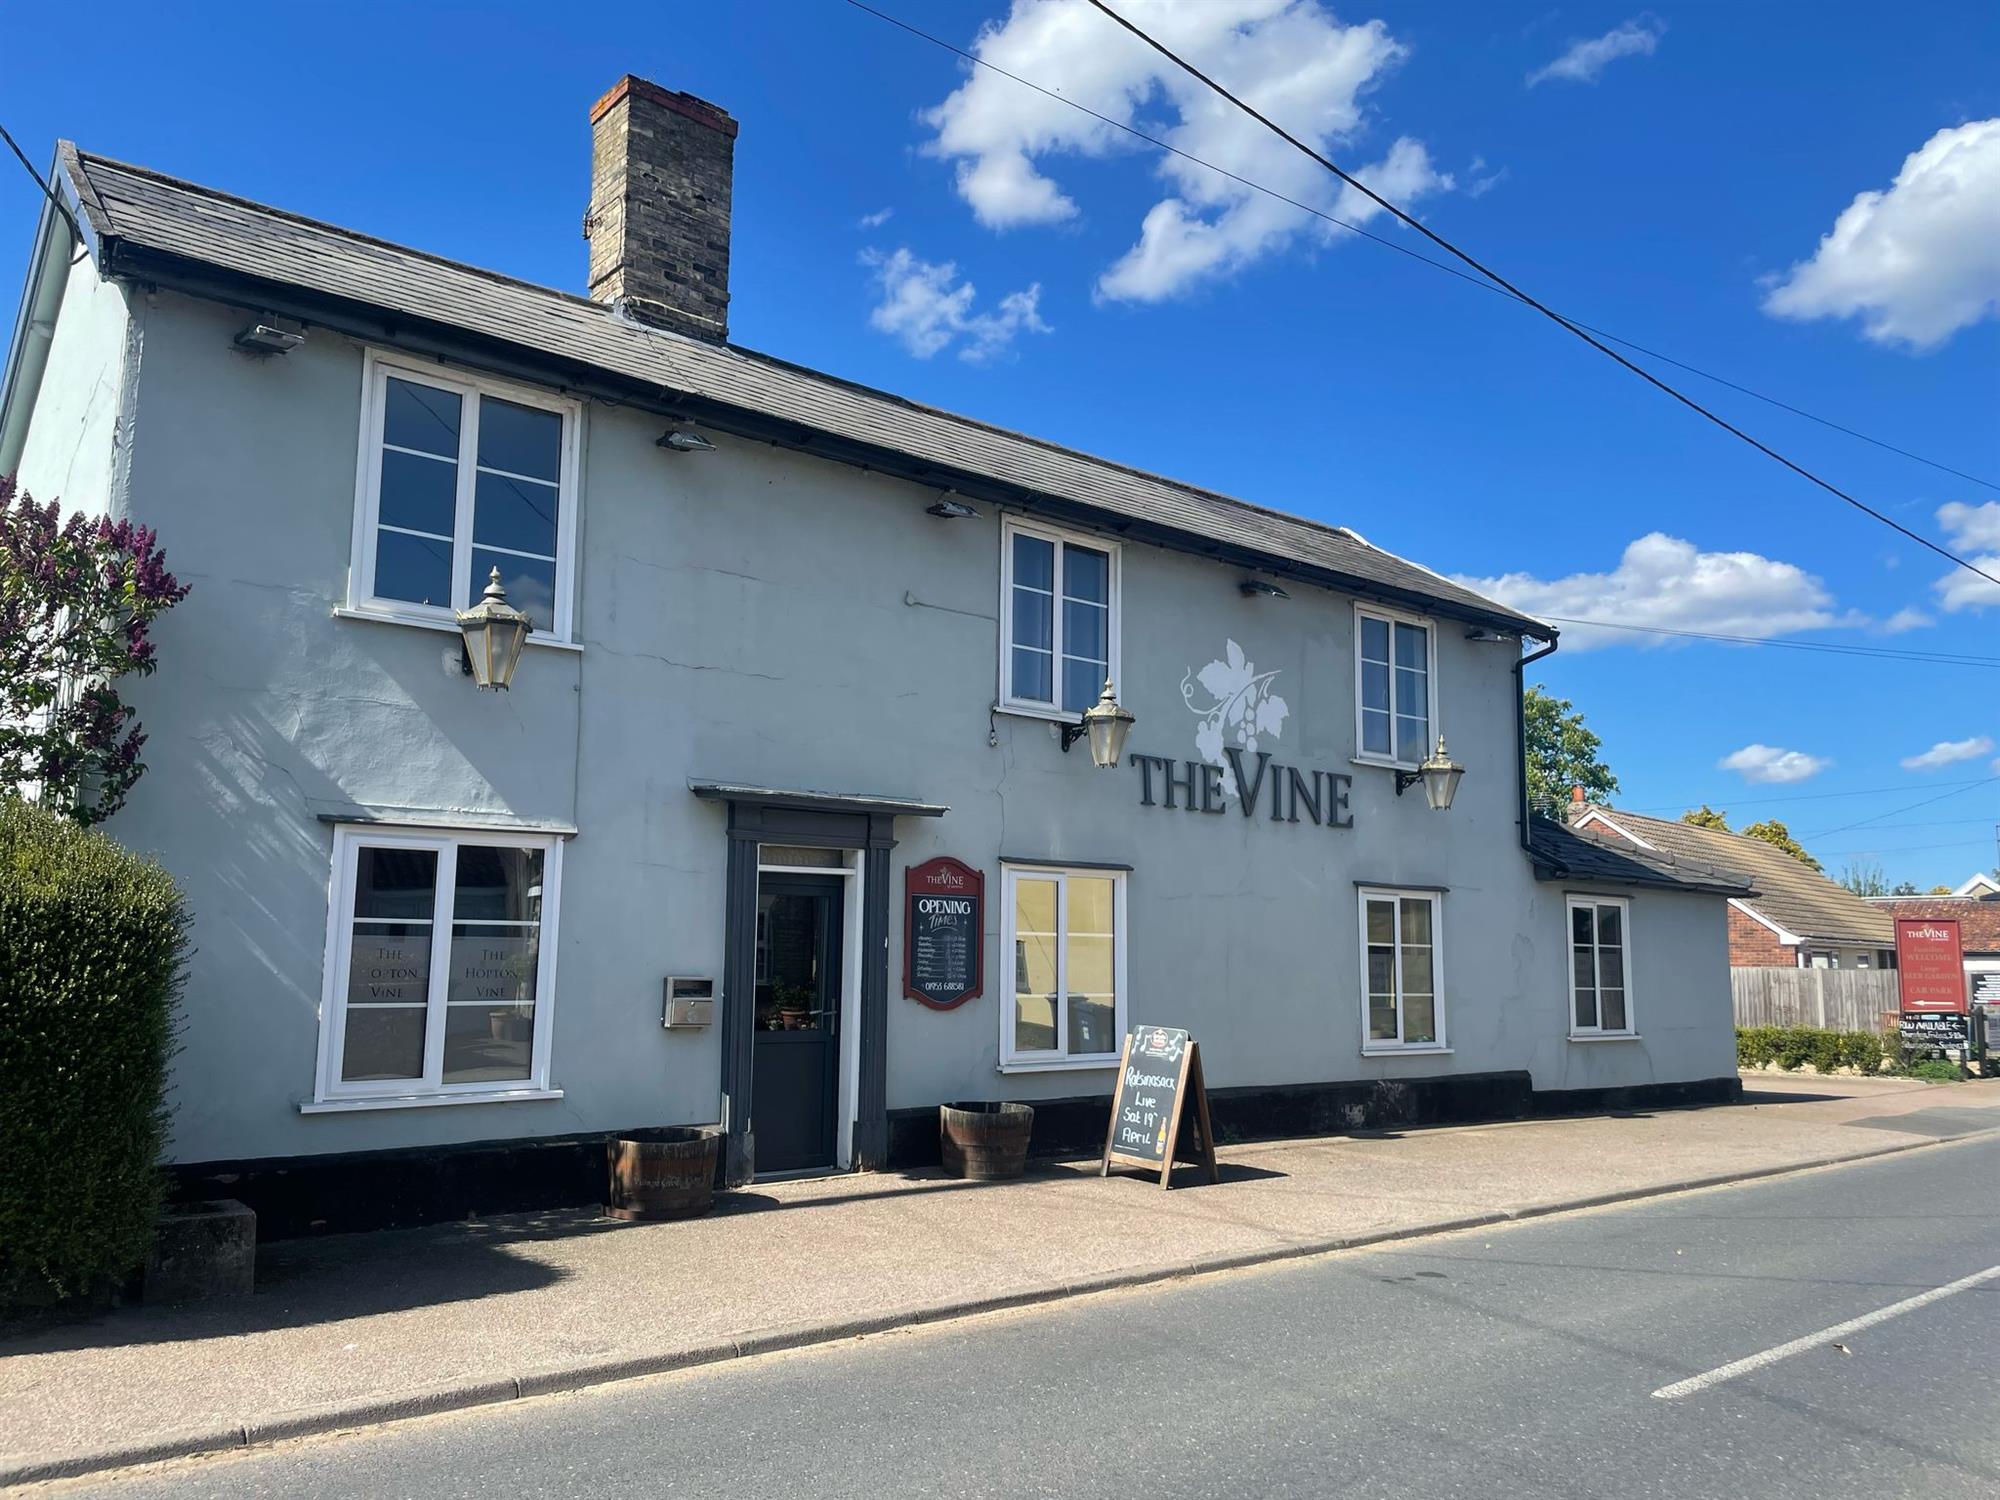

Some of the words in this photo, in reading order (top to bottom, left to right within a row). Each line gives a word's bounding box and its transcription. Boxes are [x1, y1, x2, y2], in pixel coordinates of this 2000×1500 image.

[1130, 753, 1226, 814] THE
[1223, 746, 1354, 828] VINE
[919, 898, 971, 915] OPENING
[1923, 928, 1949, 938] VINE
[1906, 953, 1953, 961] WELCOME
[1910, 986, 1929, 994] CAR
[1930, 986, 1953, 994] PARK
[1915, 1021, 1952, 1031] AVAILABLE
[1123, 1106, 1141, 1124] Sat
